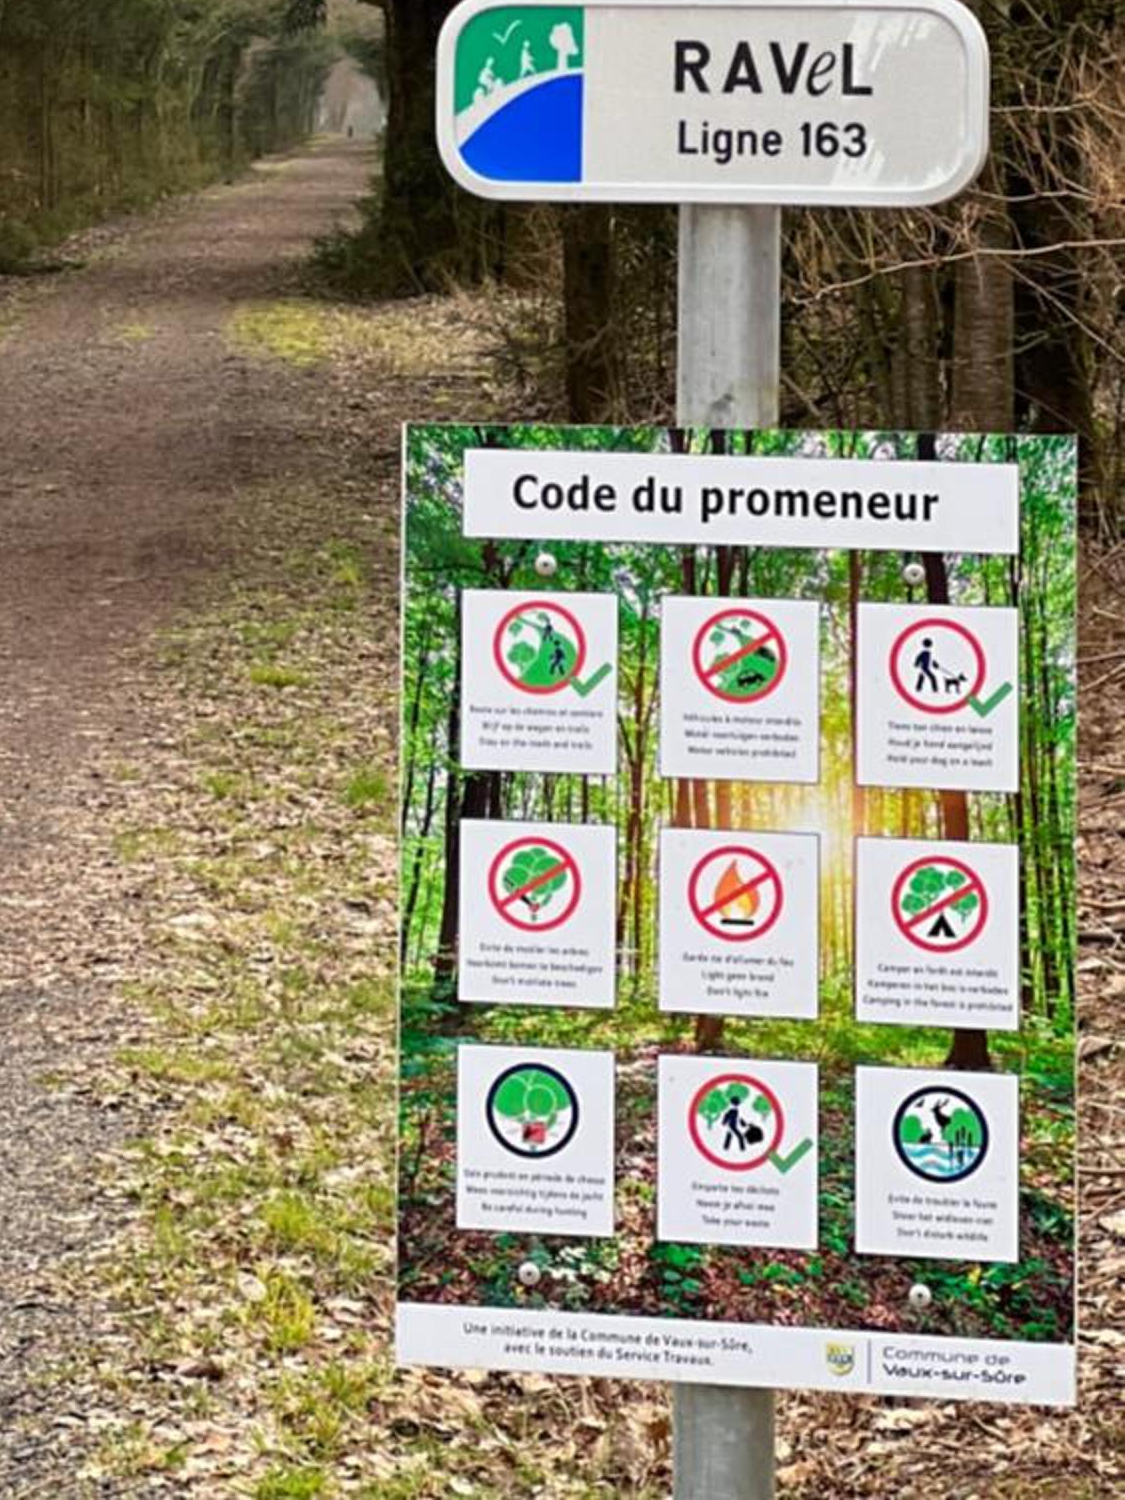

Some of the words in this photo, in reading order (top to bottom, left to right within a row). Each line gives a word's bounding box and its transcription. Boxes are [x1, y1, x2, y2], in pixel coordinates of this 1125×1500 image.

[674, 40, 873, 97] RAVeL
[678, 120, 783, 165] Ligne
[800, 121, 867, 158] 163
[512, 473, 618, 511] Code
[631, 476, 683, 513] du
[700, 485, 940, 523] promeneur
[463, 1323, 487, 1334] Une
[491, 1325, 545, 1338] initiative
[549, 1327, 563, 1339] de
[566, 1327, 577, 1340] la
[580, 1328, 641, 1344] Commune
[645, 1334, 660, 1346] de
[663, 1335, 753, 1353] Vaux-sur-Sûre,
[505, 1344, 531, 1354] avec
[535, 1342, 545, 1354] le
[549, 1345, 594, 1357] soutien
[597, 1347, 613, 1359] du
[616, 1347, 660, 1362] Service
[664, 1349, 714, 1365] Travaux.
[882, 1346, 979, 1365] Commune
[984, 1354, 1011, 1366] de
[882, 1363, 1027, 1385] Vaux-sur-Sûre
